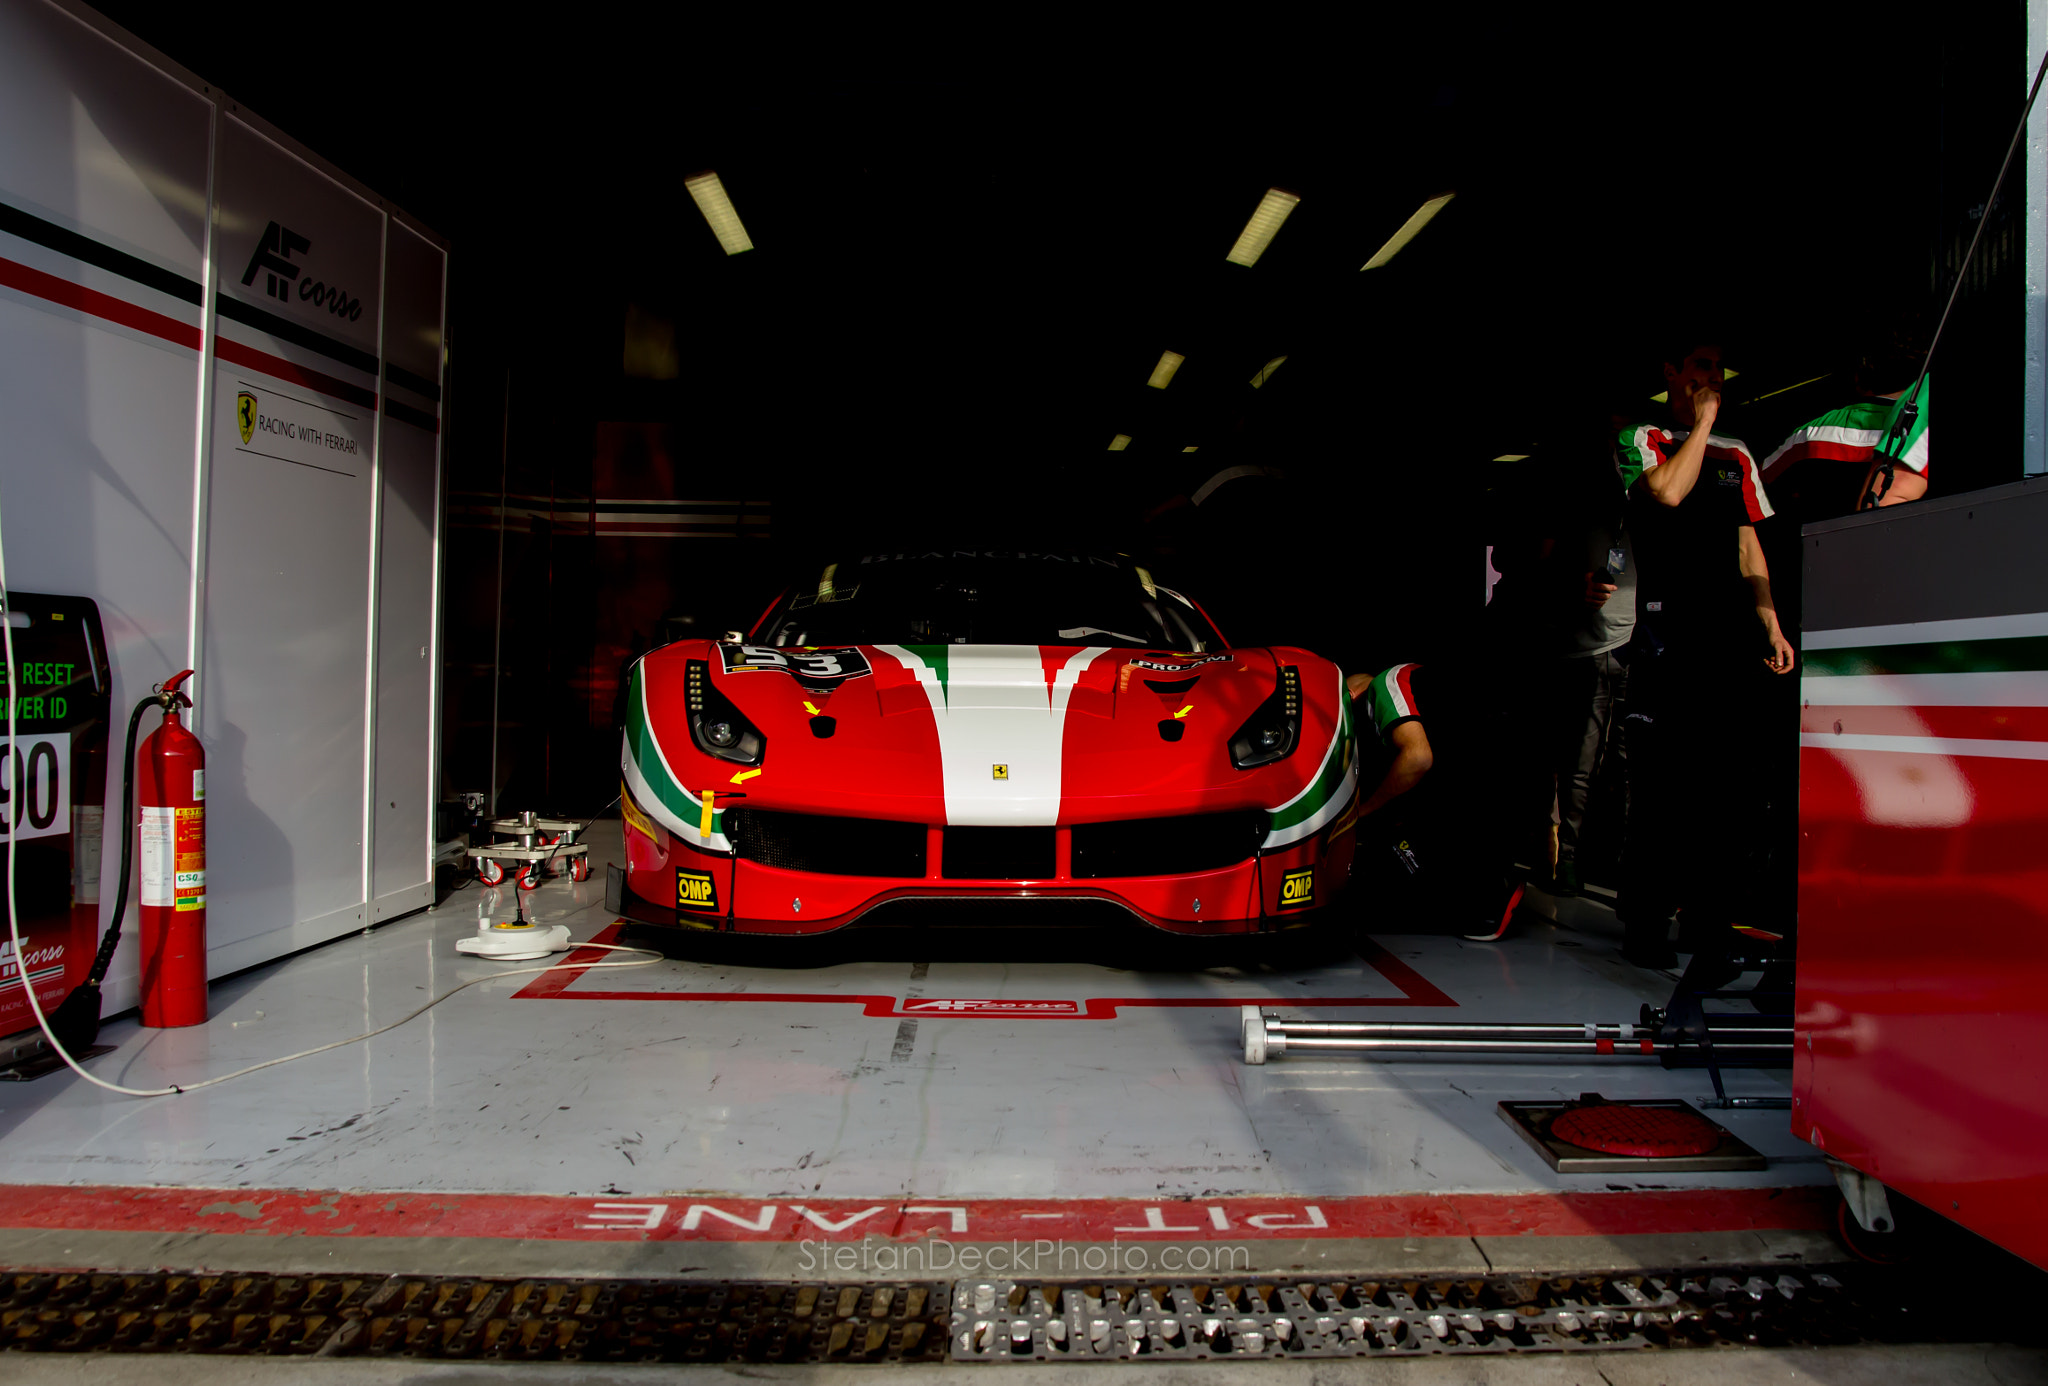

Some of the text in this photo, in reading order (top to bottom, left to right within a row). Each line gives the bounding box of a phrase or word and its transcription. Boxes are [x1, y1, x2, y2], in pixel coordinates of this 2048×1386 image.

[241, 221, 362, 321] AF corse
[259, 415, 358, 455] RACING WITH FERRARI
[22, 662, 75, 685] RESET
[741, 646, 842, 675] 53
[50, 696, 68, 719] ID
[678, 878, 712, 901] OMP
[1283, 876, 1312, 899] OMP
[575, 1202, 968, 1232] LANE
[1113, 1205, 1329, 1232] PIT
